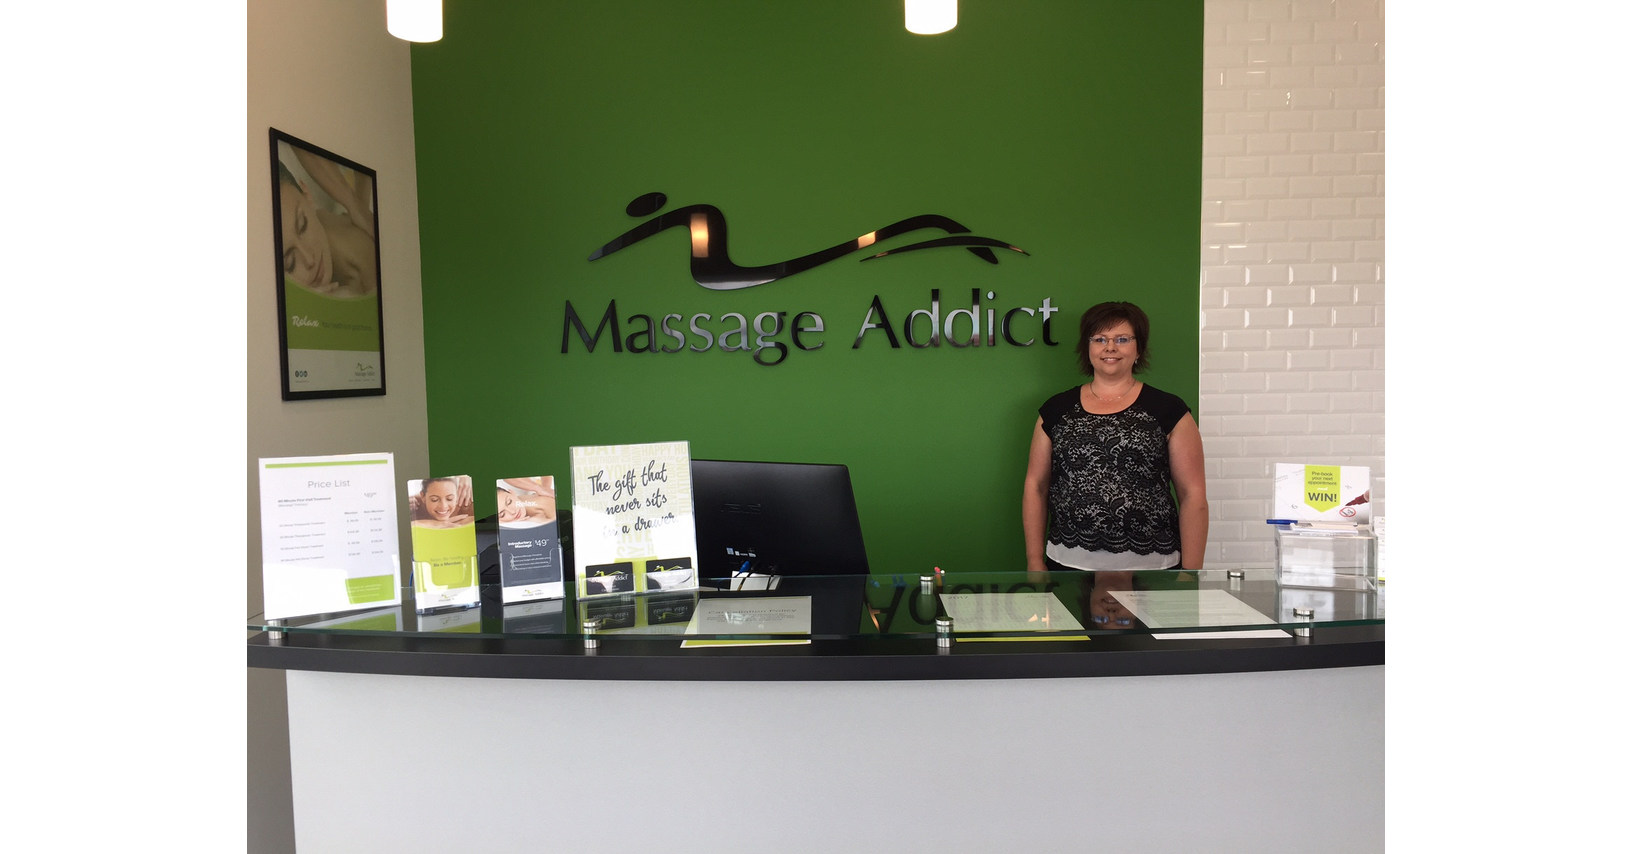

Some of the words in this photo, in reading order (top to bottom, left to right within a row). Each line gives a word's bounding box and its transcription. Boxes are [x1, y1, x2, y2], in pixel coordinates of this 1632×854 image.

[292, 315, 320, 328] Relax
[560, 299, 826, 366] Massage
[851, 288, 1060, 350] Addict
[307, 480, 332, 489] Price
[334, 479, 351, 488] List
[587, 469, 611, 496] The
[612, 468, 638, 501] gift
[640, 459, 668, 487] that
[605, 497, 641, 515] never
[646, 488, 668, 508] sits
[1308, 492, 1337, 502] WIN!
